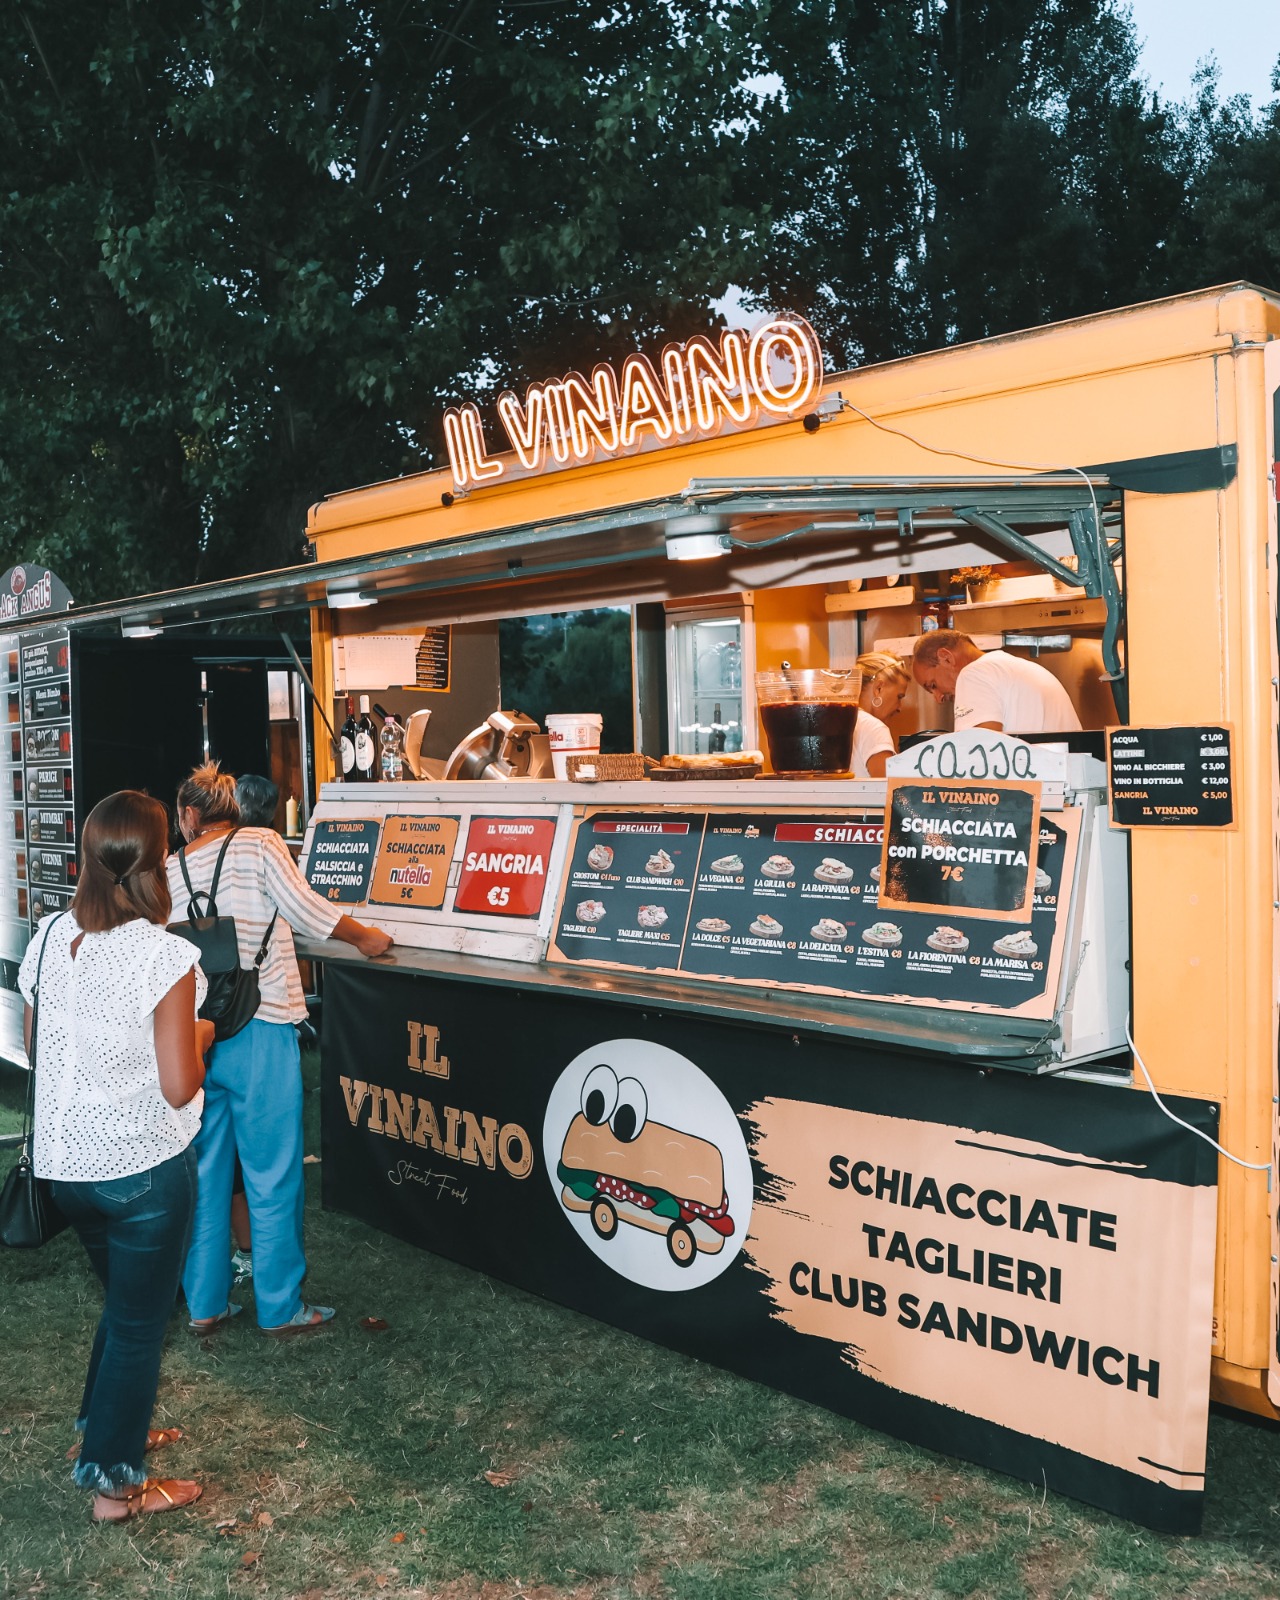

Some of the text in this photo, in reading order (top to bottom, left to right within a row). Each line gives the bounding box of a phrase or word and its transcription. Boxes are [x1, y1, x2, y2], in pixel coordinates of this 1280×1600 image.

[444, 320, 815, 487] IL VINAINO
[0, 570, 52, 619] ACK ANGUS
[1113, 736, 1138, 744] ACQUA
[1208, 734, 1222, 742] 1,00
[38, 771, 57, 782] PARIGI
[922, 792, 1000, 806] IL VINAINO
[1210, 792, 1228, 800] 5,00
[1142, 806, 1198, 815] IL VINAINO
[40, 812, 63, 824] MUMBAI
[328, 824, 364, 832] IL VINAINO
[400, 823, 441, 831] IL VINAINO
[487, 825, 534, 834] IL VINAINO
[616, 822, 663, 832] SPECIALITÀ
[901, 817, 1017, 839] SCHIACCIATA
[814, 828, 884, 842] SCHIACC
[316, 842, 369, 854] SCHIACCIATA
[386, 842, 446, 855] SCHIACCIATA
[42, 853, 62, 866] VIENNA
[408, 856, 419, 864] alla
[888, 845, 1028, 867] con PORCHETTA
[315, 860, 363, 872] SALSICCIA e
[465, 852, 544, 875] SANGRIA
[310, 874, 363, 886] STRACCHINO
[390, 866, 431, 885] nutella
[700, 874, 708, 882] LA
[708, 875, 733, 883] VEGANA
[941, 866, 965, 882] 7€
[626, 876, 641, 884] CLUB
[641, 877, 672, 885] SANDWICH
[754, 879, 763, 887] LA
[764, 880, 785, 888] GIULIA
[328, 888, 340, 898] 8€
[401, 888, 413, 899] 5€
[811, 885, 849, 893] RAFFINATA
[864, 885, 875, 893] LA
[43, 894, 60, 907] VIOLA
[487, 886, 510, 906] €5
[1044, 895, 1056, 904] €8
[563, 924, 586, 932] TAGLIERE
[618, 929, 644, 938] TAGLIERE
[644, 932, 660, 940] MAXI
[692, 933, 700, 941] LA
[700, 934, 721, 943] DOLCE
[732, 937, 741, 945] LA
[742, 938, 786, 949] VEGETARIANA
[799, 941, 809, 950] LA
[810, 942, 842, 952] DELICATA
[857, 947, 889, 958] L'ESTIVA
[891, 950, 902, 958] €8
[908, 950, 980, 965] LA FIORENTINA €8
[982, 957, 1044, 970] LA MARISA €8
[408, 1020, 450, 1080] IL
[340, 1075, 534, 1180] VINAINO
[388, 1160, 468, 1205] Street Food
[828, 1154, 1117, 1252] SCHIACCIATE
[862, 1222, 1062, 1305] TAGLIERI
[789, 1262, 1160, 1400] CLUB SANDWICH
